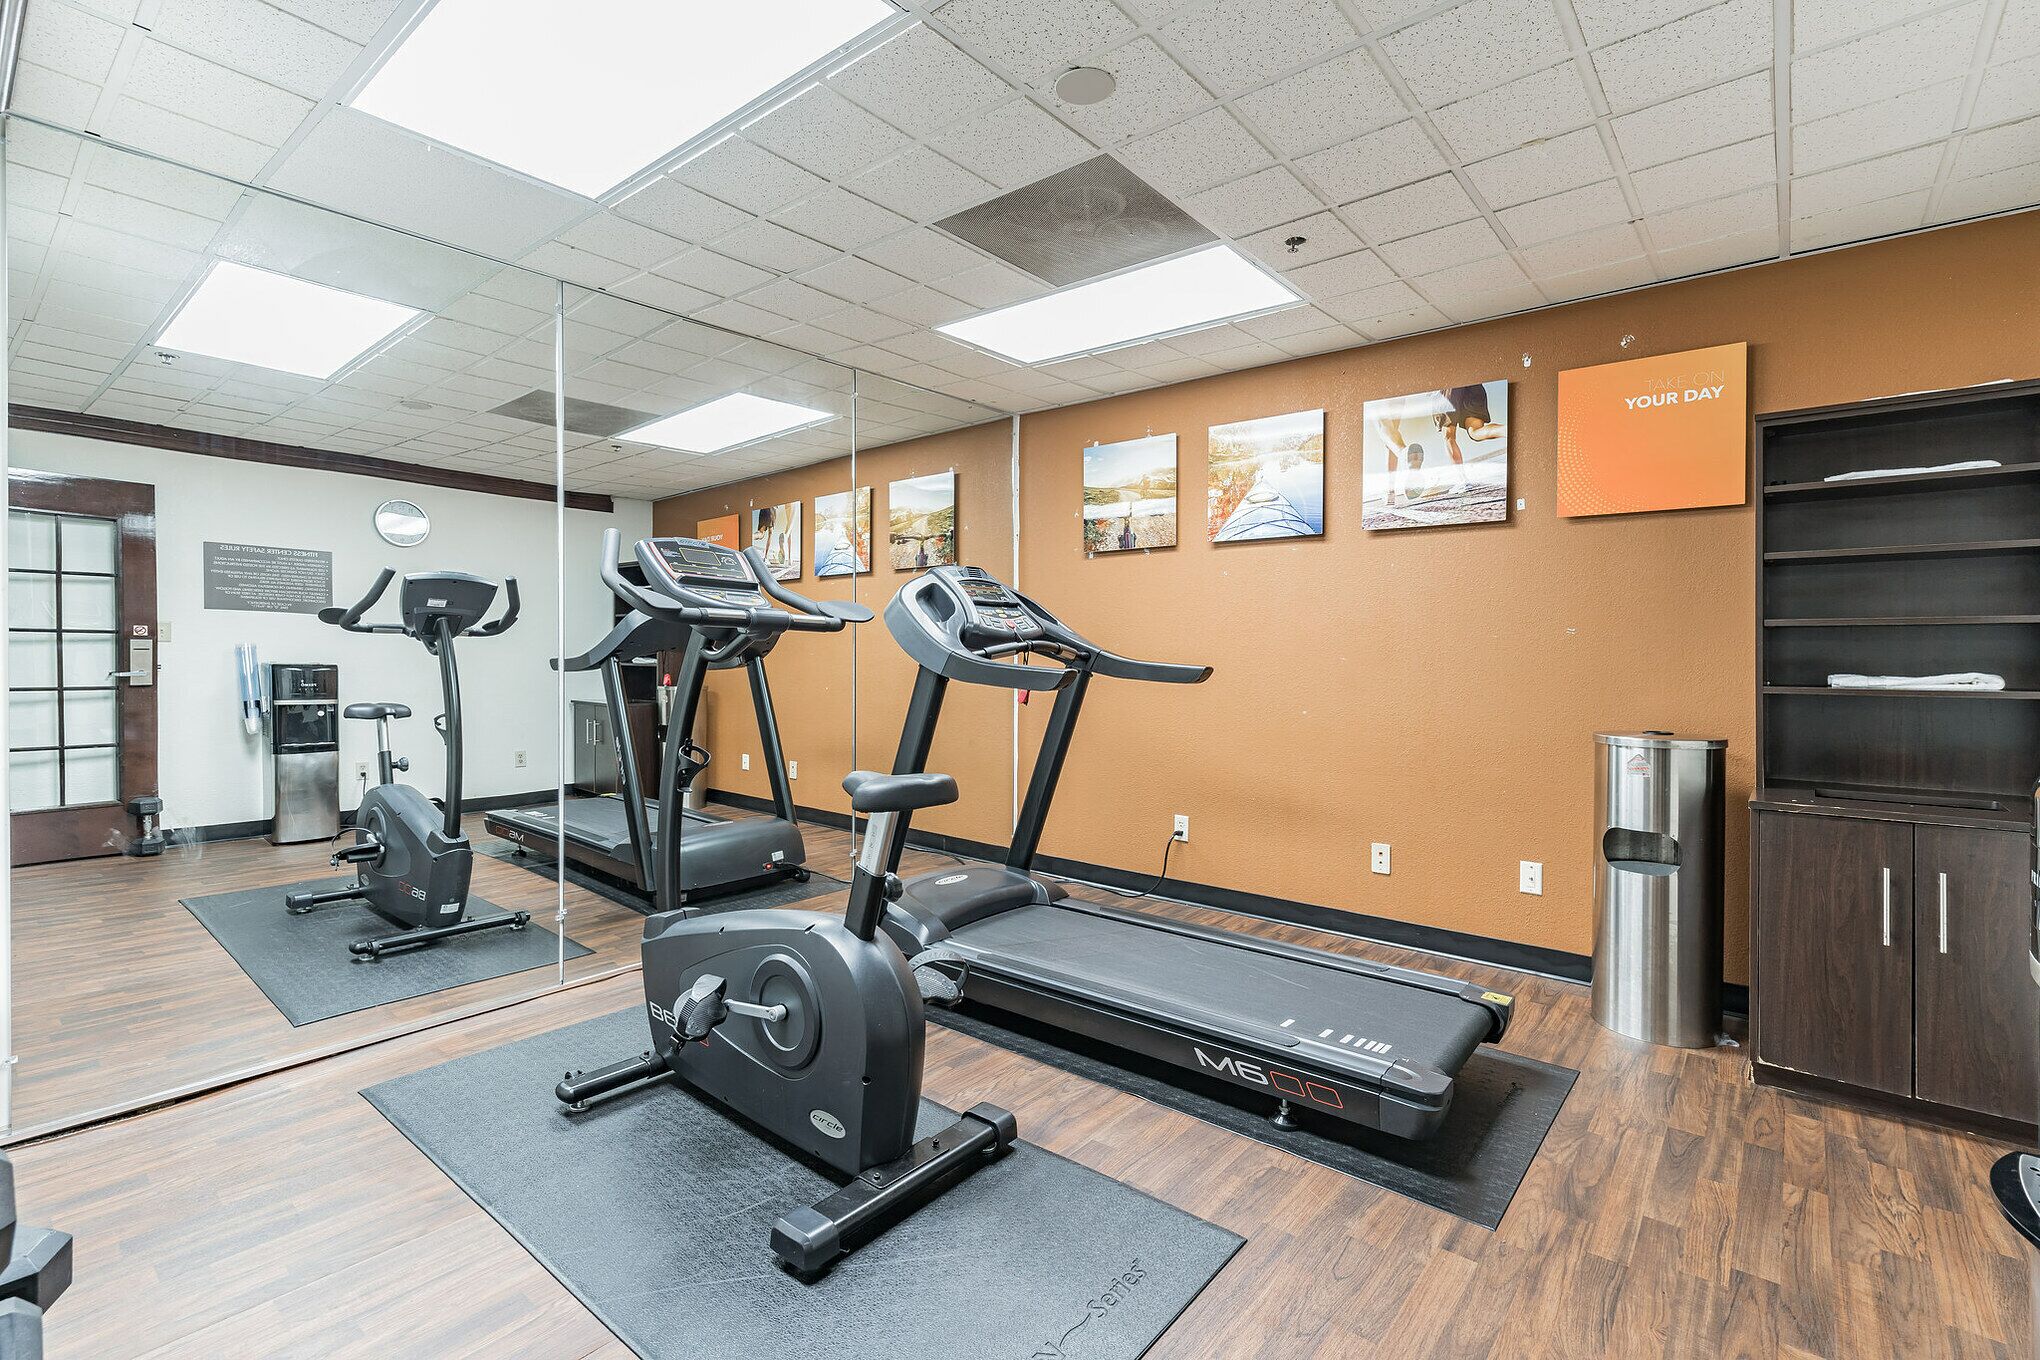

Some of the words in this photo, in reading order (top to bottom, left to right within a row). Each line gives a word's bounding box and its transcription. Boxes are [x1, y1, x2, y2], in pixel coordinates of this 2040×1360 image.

[1645, 375, 1686, 391] TAKE
[1693, 370, 1725, 386] ON
[1625, 392, 1678, 409] YOUR
[1684, 385, 1725, 403] DAY
[1193, 1047, 1344, 1109] M600
[812, 1114, 843, 1132] circle
[1087, 1262, 1148, 1319] Series
